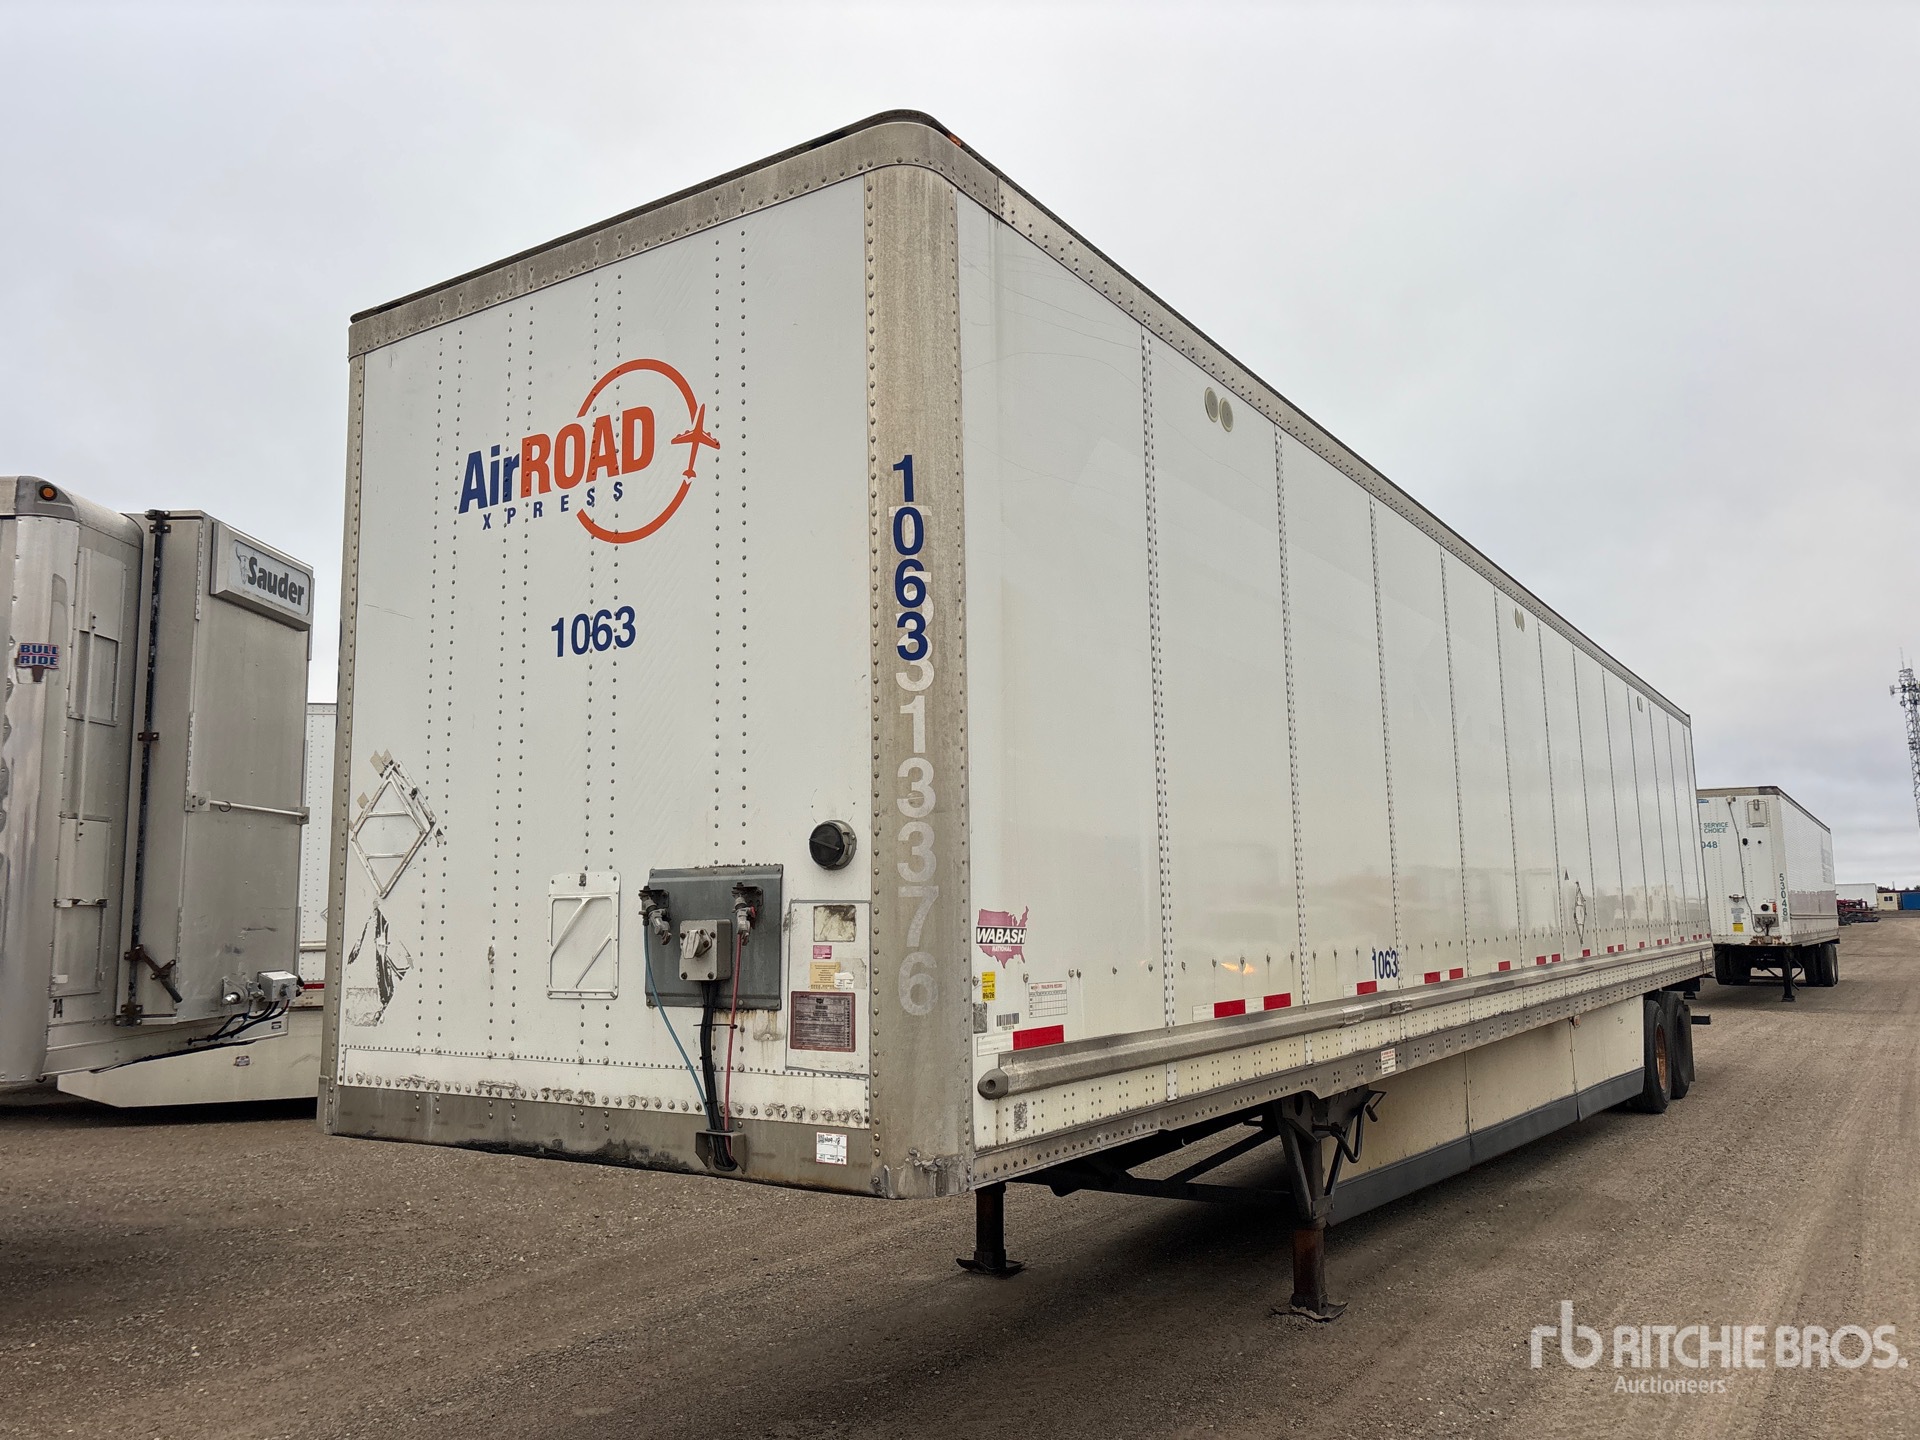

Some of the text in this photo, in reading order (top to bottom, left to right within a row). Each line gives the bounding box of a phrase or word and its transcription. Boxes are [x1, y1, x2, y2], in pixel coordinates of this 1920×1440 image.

[458, 406, 656, 514] AirROAD
[482, 481, 624, 530] XPRESS
[247, 556, 305, 605] Sauder
[892, 455, 928, 661] 1063
[20, 644, 58, 654] BULL
[551, 605, 637, 658] 1063
[20, 655, 58, 665] RIDE
[1779, 873, 1789, 916] 53048
[976, 928, 1027, 944] WABASH
[1371, 950, 1398, 980] 1063
